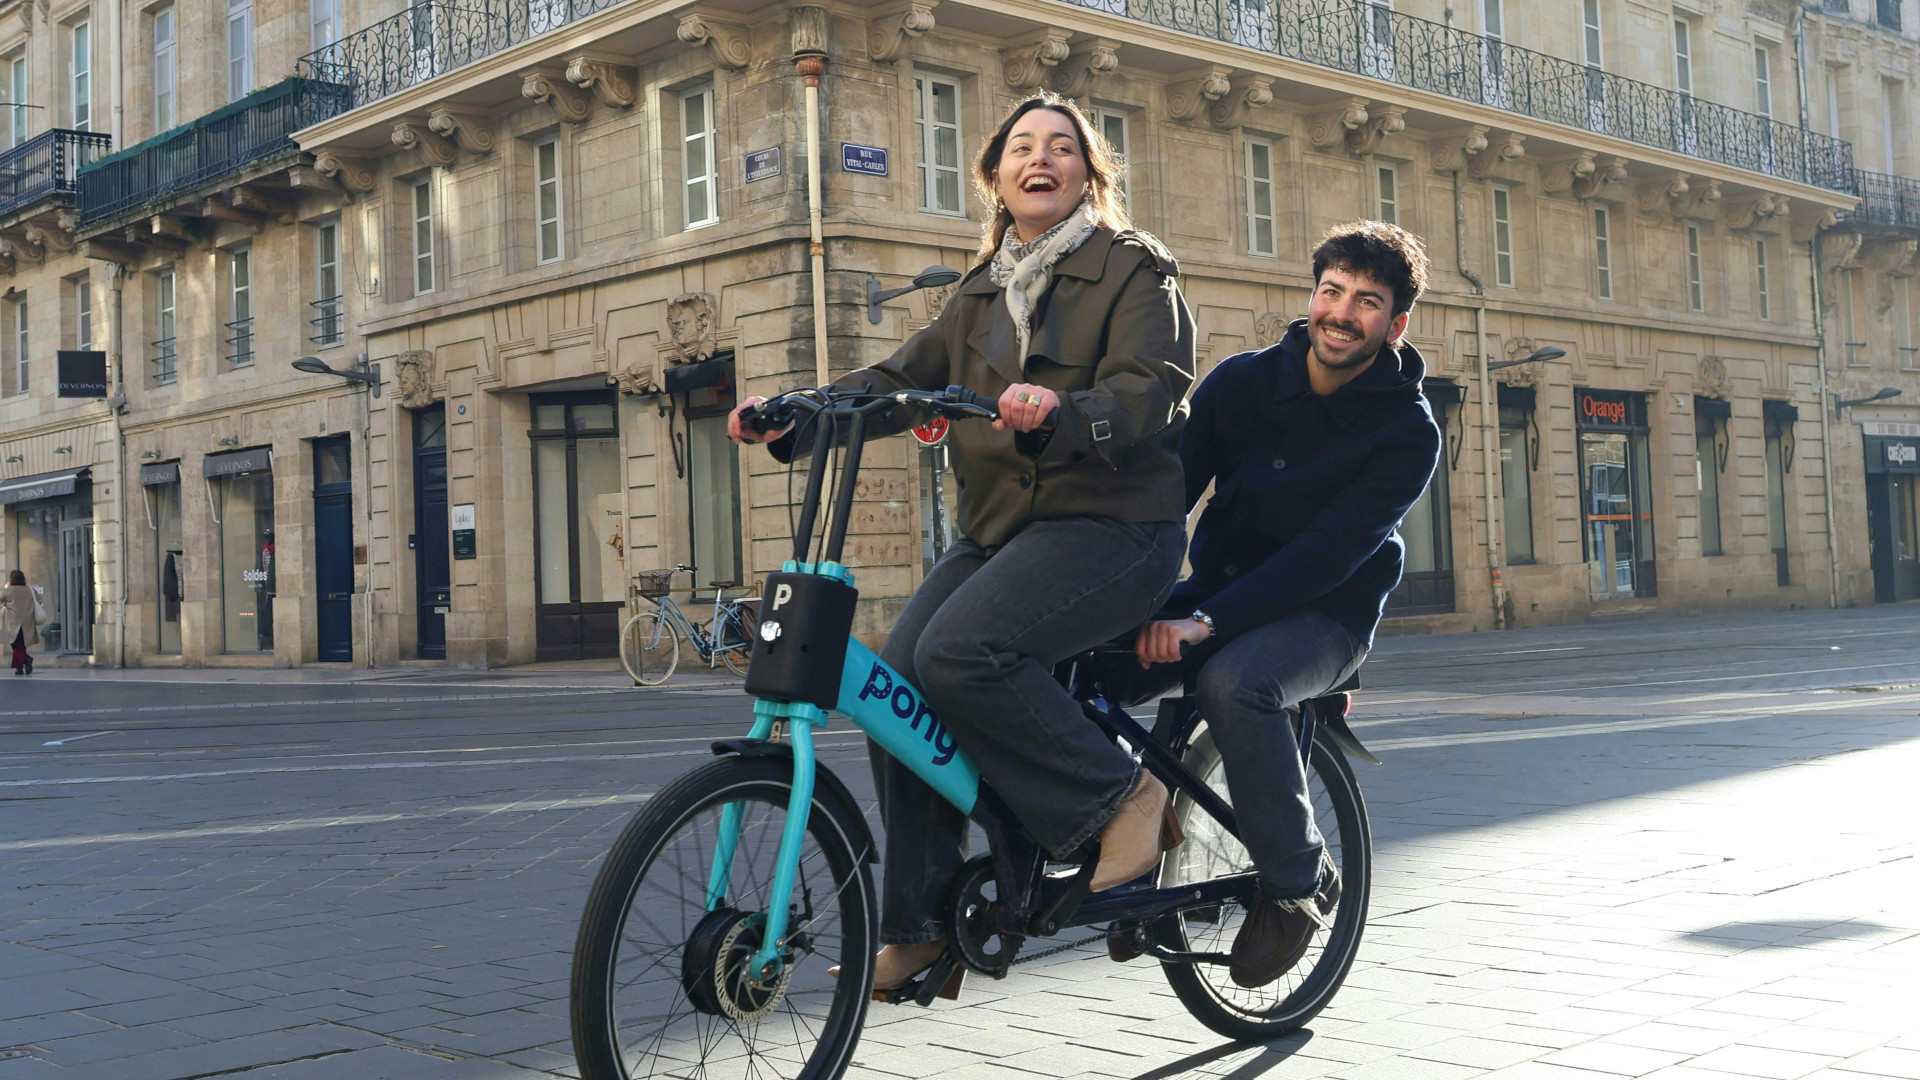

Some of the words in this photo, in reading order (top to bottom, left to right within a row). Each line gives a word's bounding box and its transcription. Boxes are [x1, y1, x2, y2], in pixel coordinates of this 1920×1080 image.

[754, 152, 769, 162] COURS
[860, 149, 873, 159] RUE
[846, 158, 885, 171] VITAL-CARLES
[1583, 395, 1626, 423] Orange
[243, 569, 268, 582] Soldes
